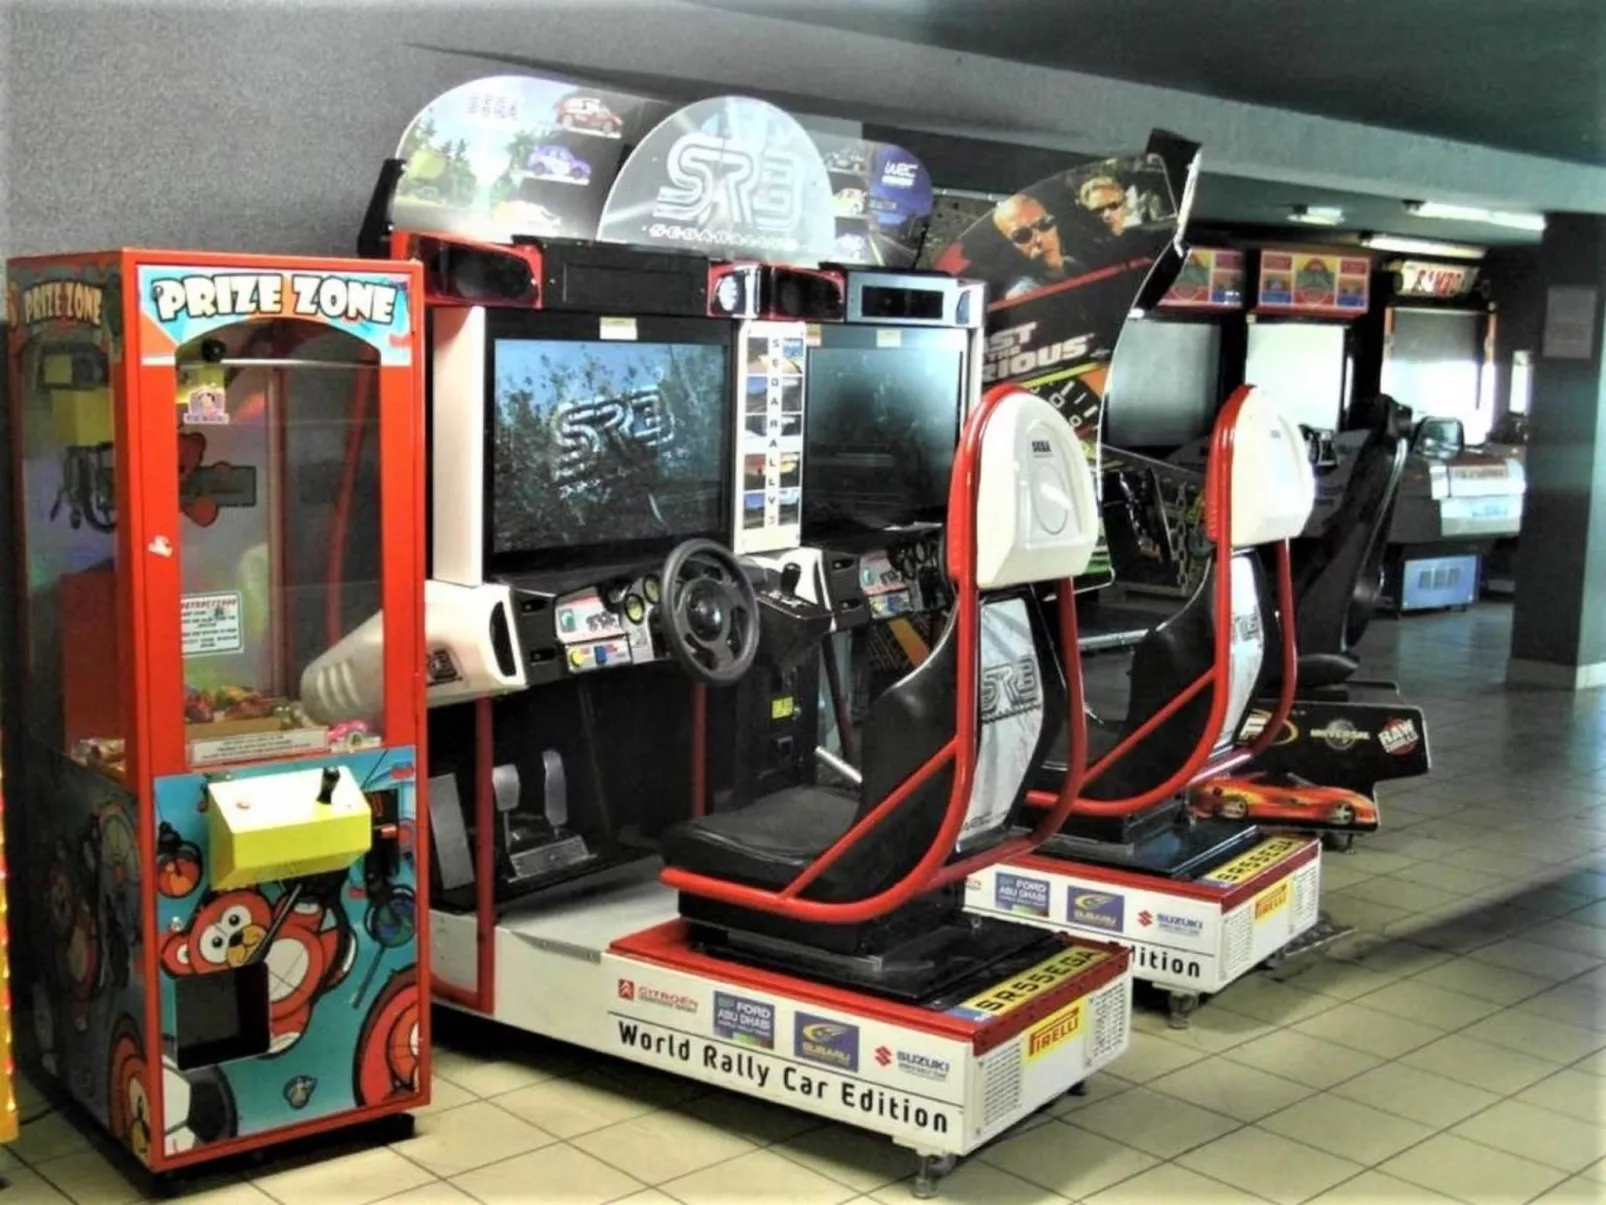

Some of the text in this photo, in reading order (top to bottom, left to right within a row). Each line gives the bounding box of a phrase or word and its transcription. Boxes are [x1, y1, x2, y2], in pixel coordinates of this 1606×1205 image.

[24, 281, 103, 325] PRIZE ZONE
[152, 273, 397, 325] PRIZE ZONE
[984, 321, 1037, 347] ST
[1015, 878, 1047, 893] FORD
[1157, 912, 1203, 930] SUZUKI
[1132, 945, 1200, 978] ition
[717, 1008, 739, 1022] ABU
[739, 1013, 771, 1030] DHABI
[736, 1001, 771, 1019] FORD
[1029, 1006, 1080, 1058] PIRELLI
[897, 1050, 950, 1073] SUZUKI
[618, 1021, 691, 1061] World
[703, 1045, 770, 1087] Rally
[783, 1066, 828, 1099] Car
[841, 1082, 948, 1133] Edition
